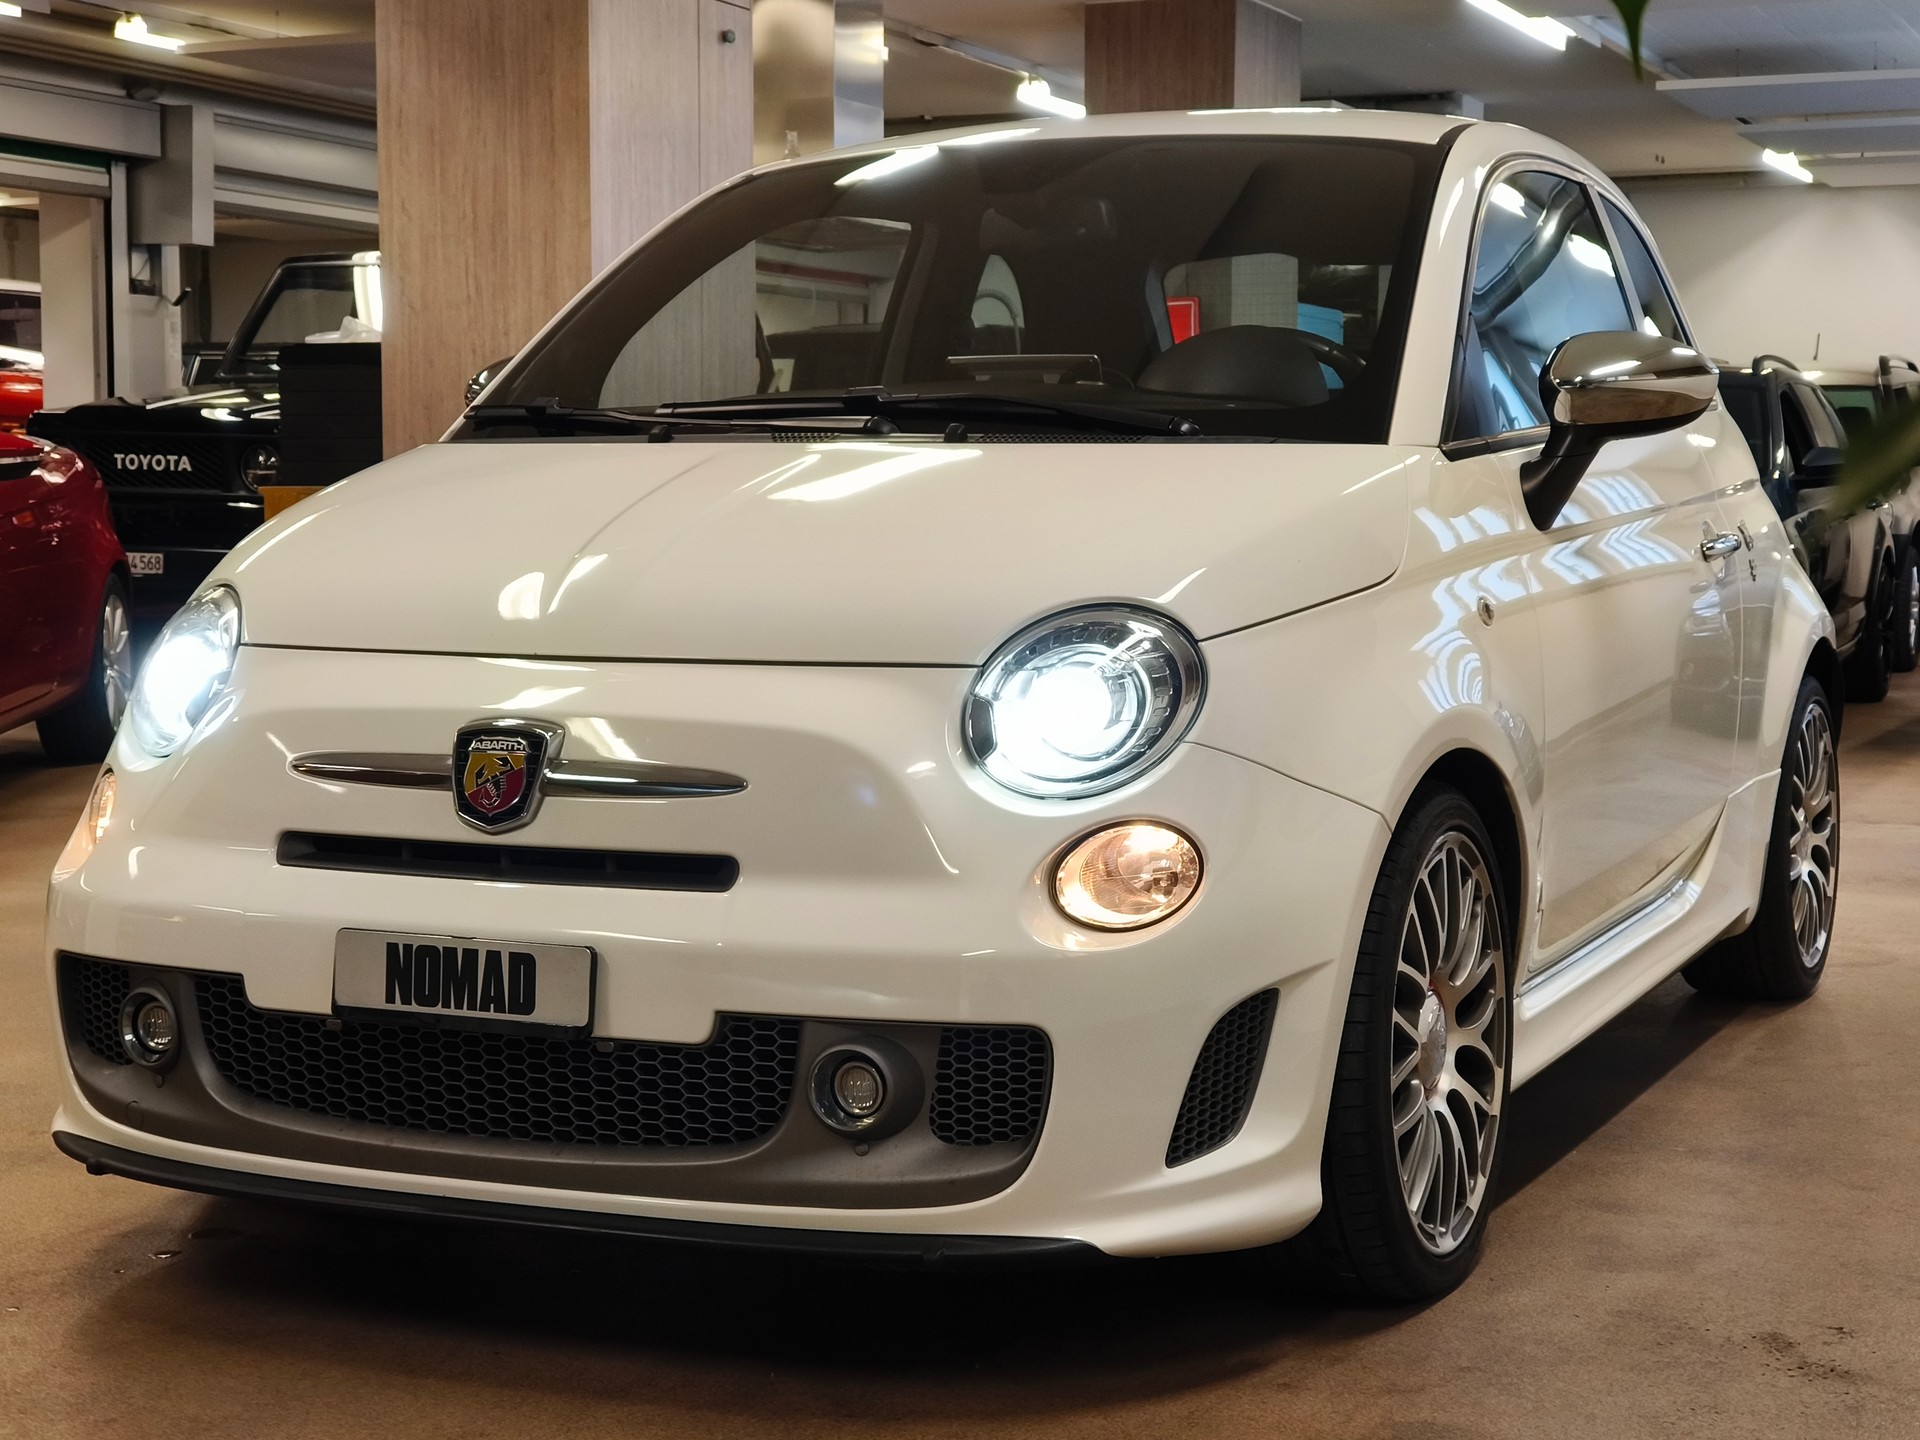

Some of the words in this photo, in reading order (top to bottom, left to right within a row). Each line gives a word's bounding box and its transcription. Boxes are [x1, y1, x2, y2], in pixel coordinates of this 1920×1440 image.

[113, 453, 193, 472] TOYOTA
[473, 740, 525, 751] ABARTH
[385, 941, 537, 1016] NOMAD
